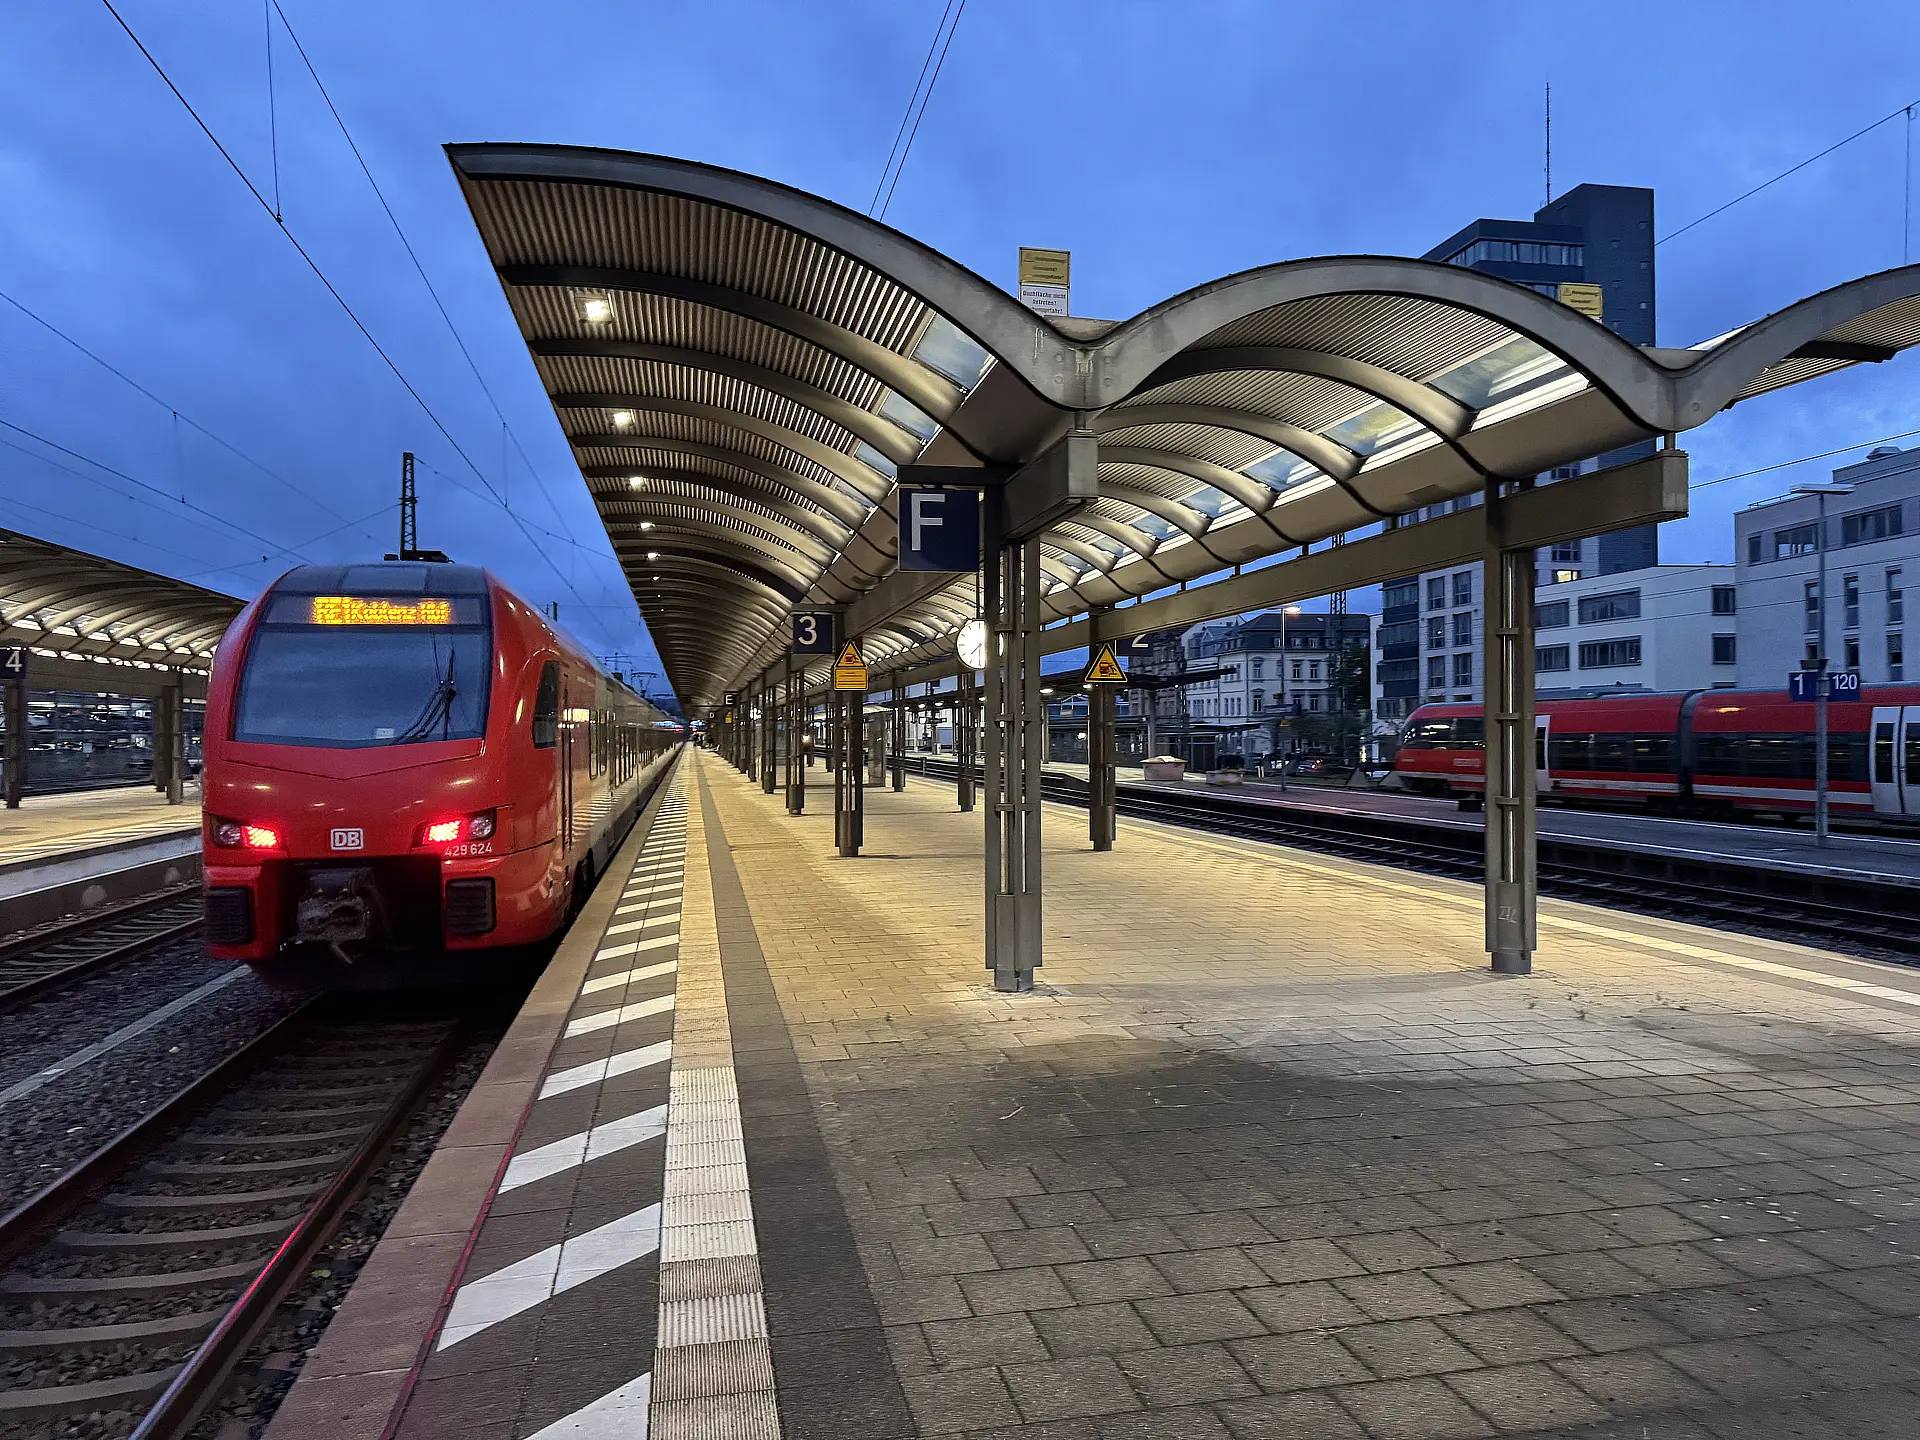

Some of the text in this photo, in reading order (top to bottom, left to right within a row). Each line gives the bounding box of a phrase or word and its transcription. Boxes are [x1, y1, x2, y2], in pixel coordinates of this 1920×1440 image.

[910, 492, 946, 551] F
[798, 615, 817, 645] 3
[5, 651, 23, 672] 4
[1793, 673, 1804, 695] 1
[1832, 673, 1858, 690] 120
[725, 694, 733, 705] E
[1588, 733, 1596, 744] 2
[334, 831, 360, 847] DB
[444, 842, 493, 856] 429 624
